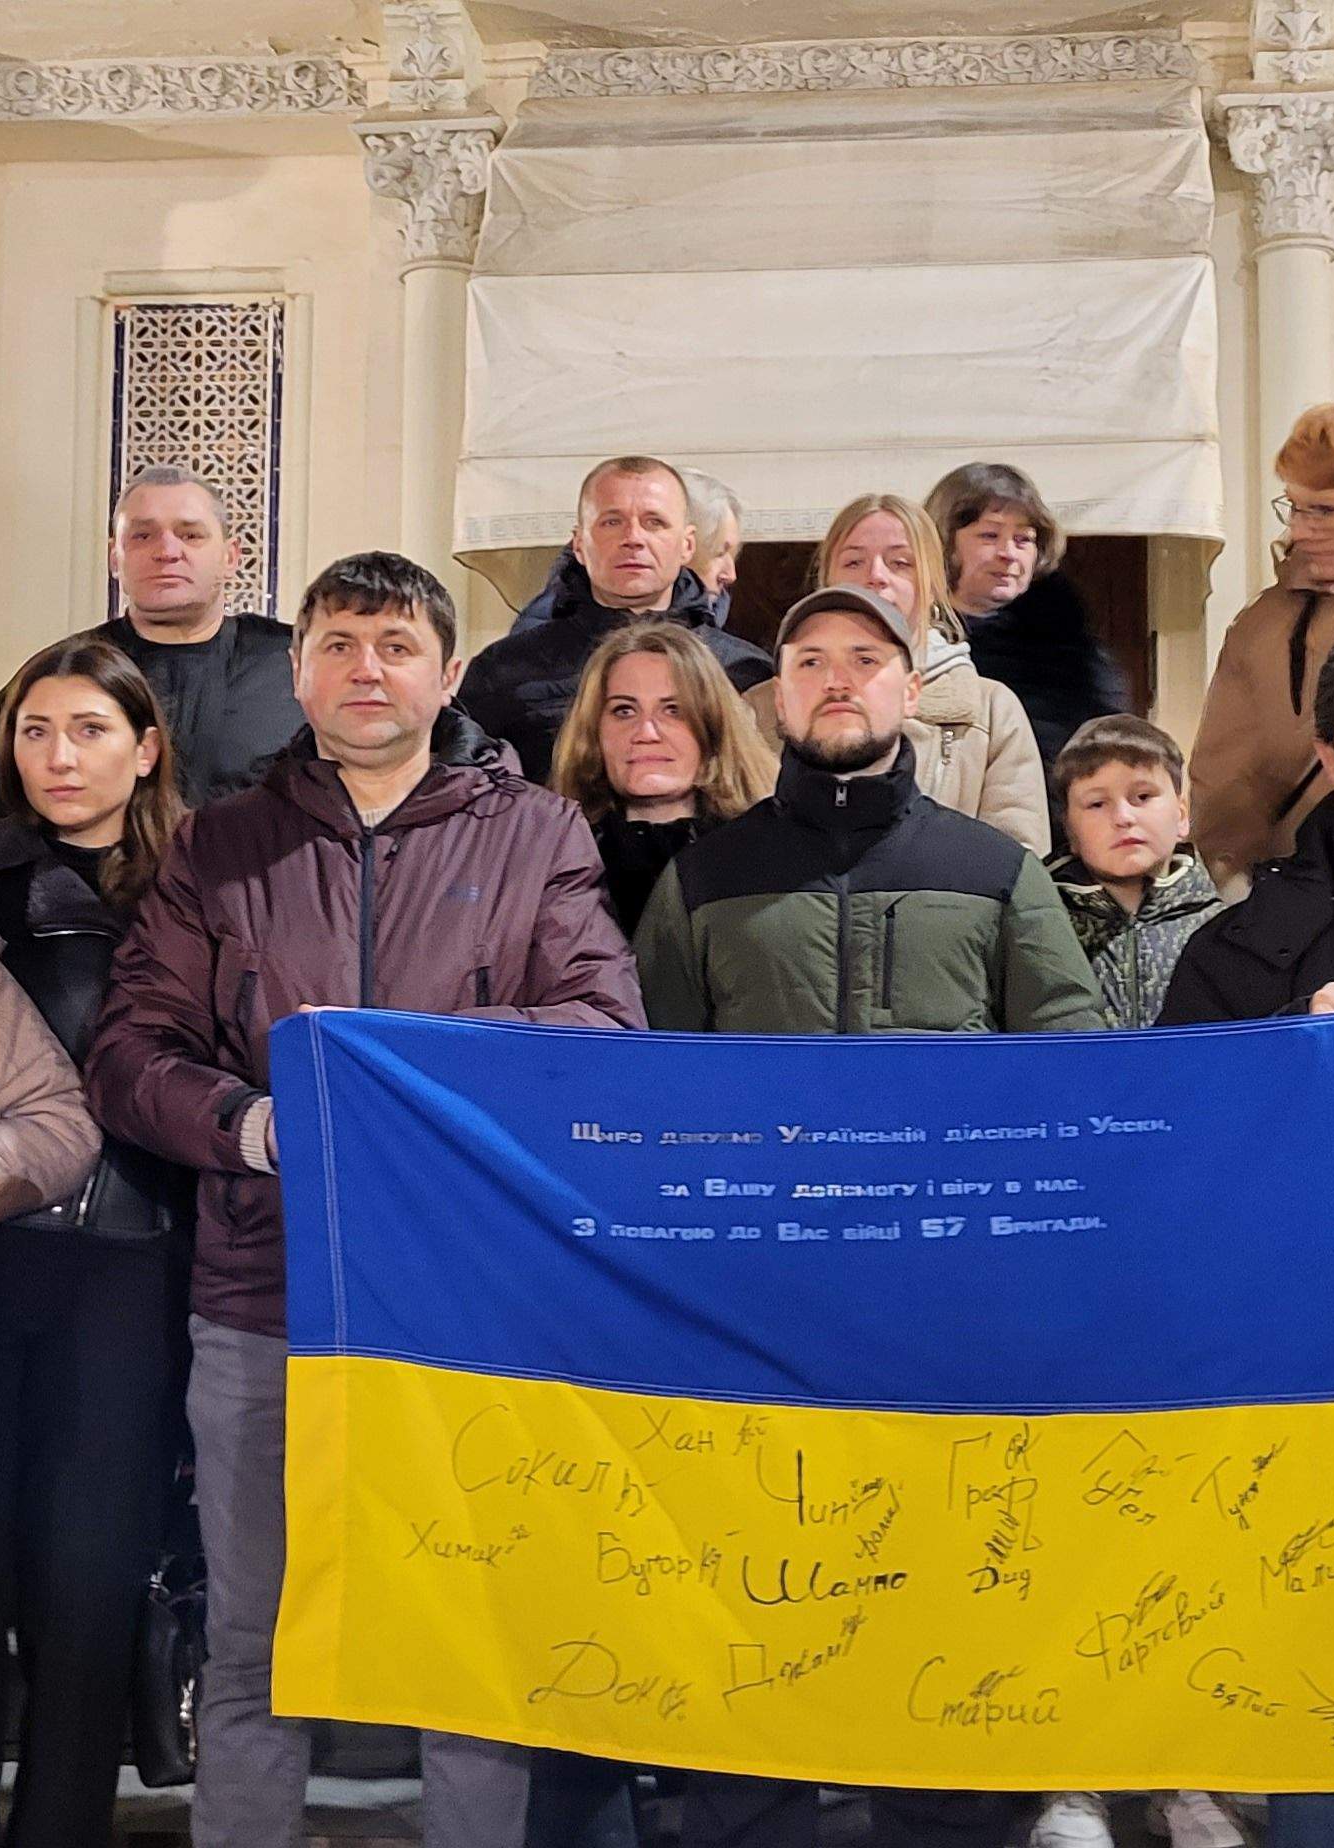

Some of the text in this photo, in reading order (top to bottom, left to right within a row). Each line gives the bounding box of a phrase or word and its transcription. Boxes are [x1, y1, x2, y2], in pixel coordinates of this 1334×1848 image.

[1058, 1121, 1080, 1138] із
[660, 1184, 690, 1197] за
[727, 1226, 762, 1240] до
[777, 1222, 830, 1242] Вас
[921, 1216, 966, 1238] 57
[635, 1407, 715, 1453] Хан
